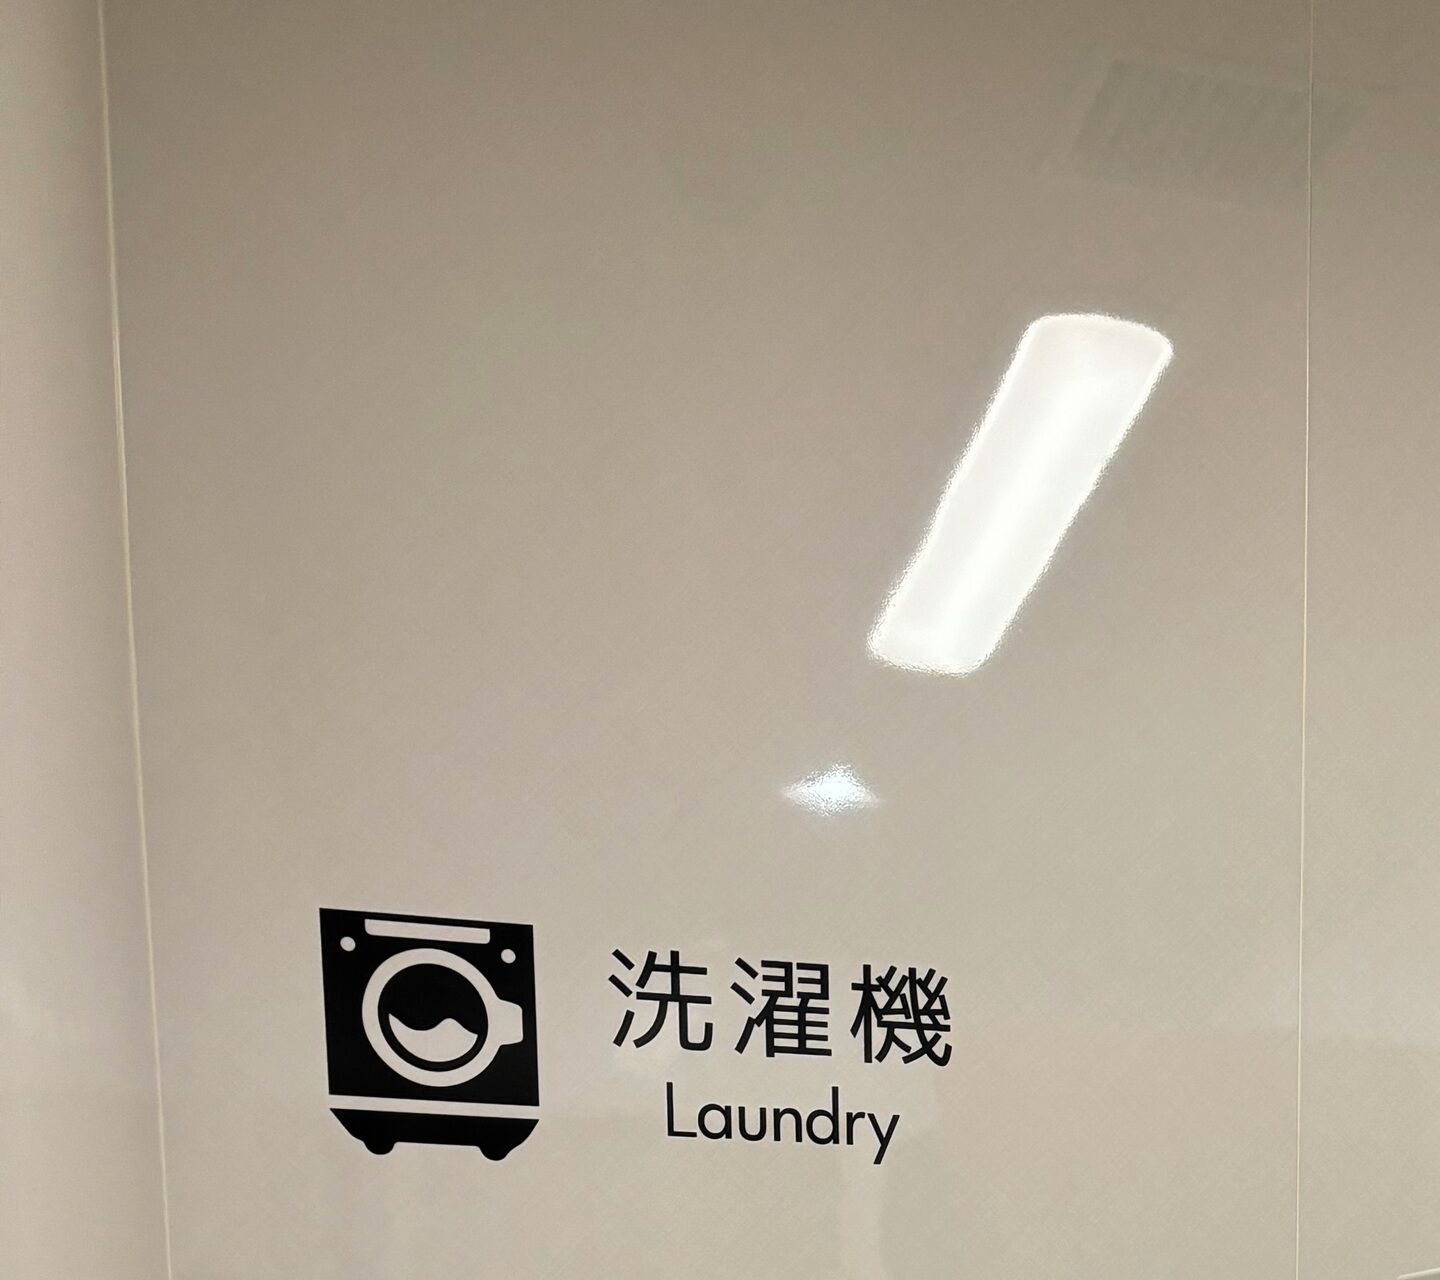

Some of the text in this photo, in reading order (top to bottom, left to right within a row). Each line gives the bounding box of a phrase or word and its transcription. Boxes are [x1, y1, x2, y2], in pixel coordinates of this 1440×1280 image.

[607, 948, 953, 1067] 洗濯機
[665, 1081, 900, 1165] Laundry
